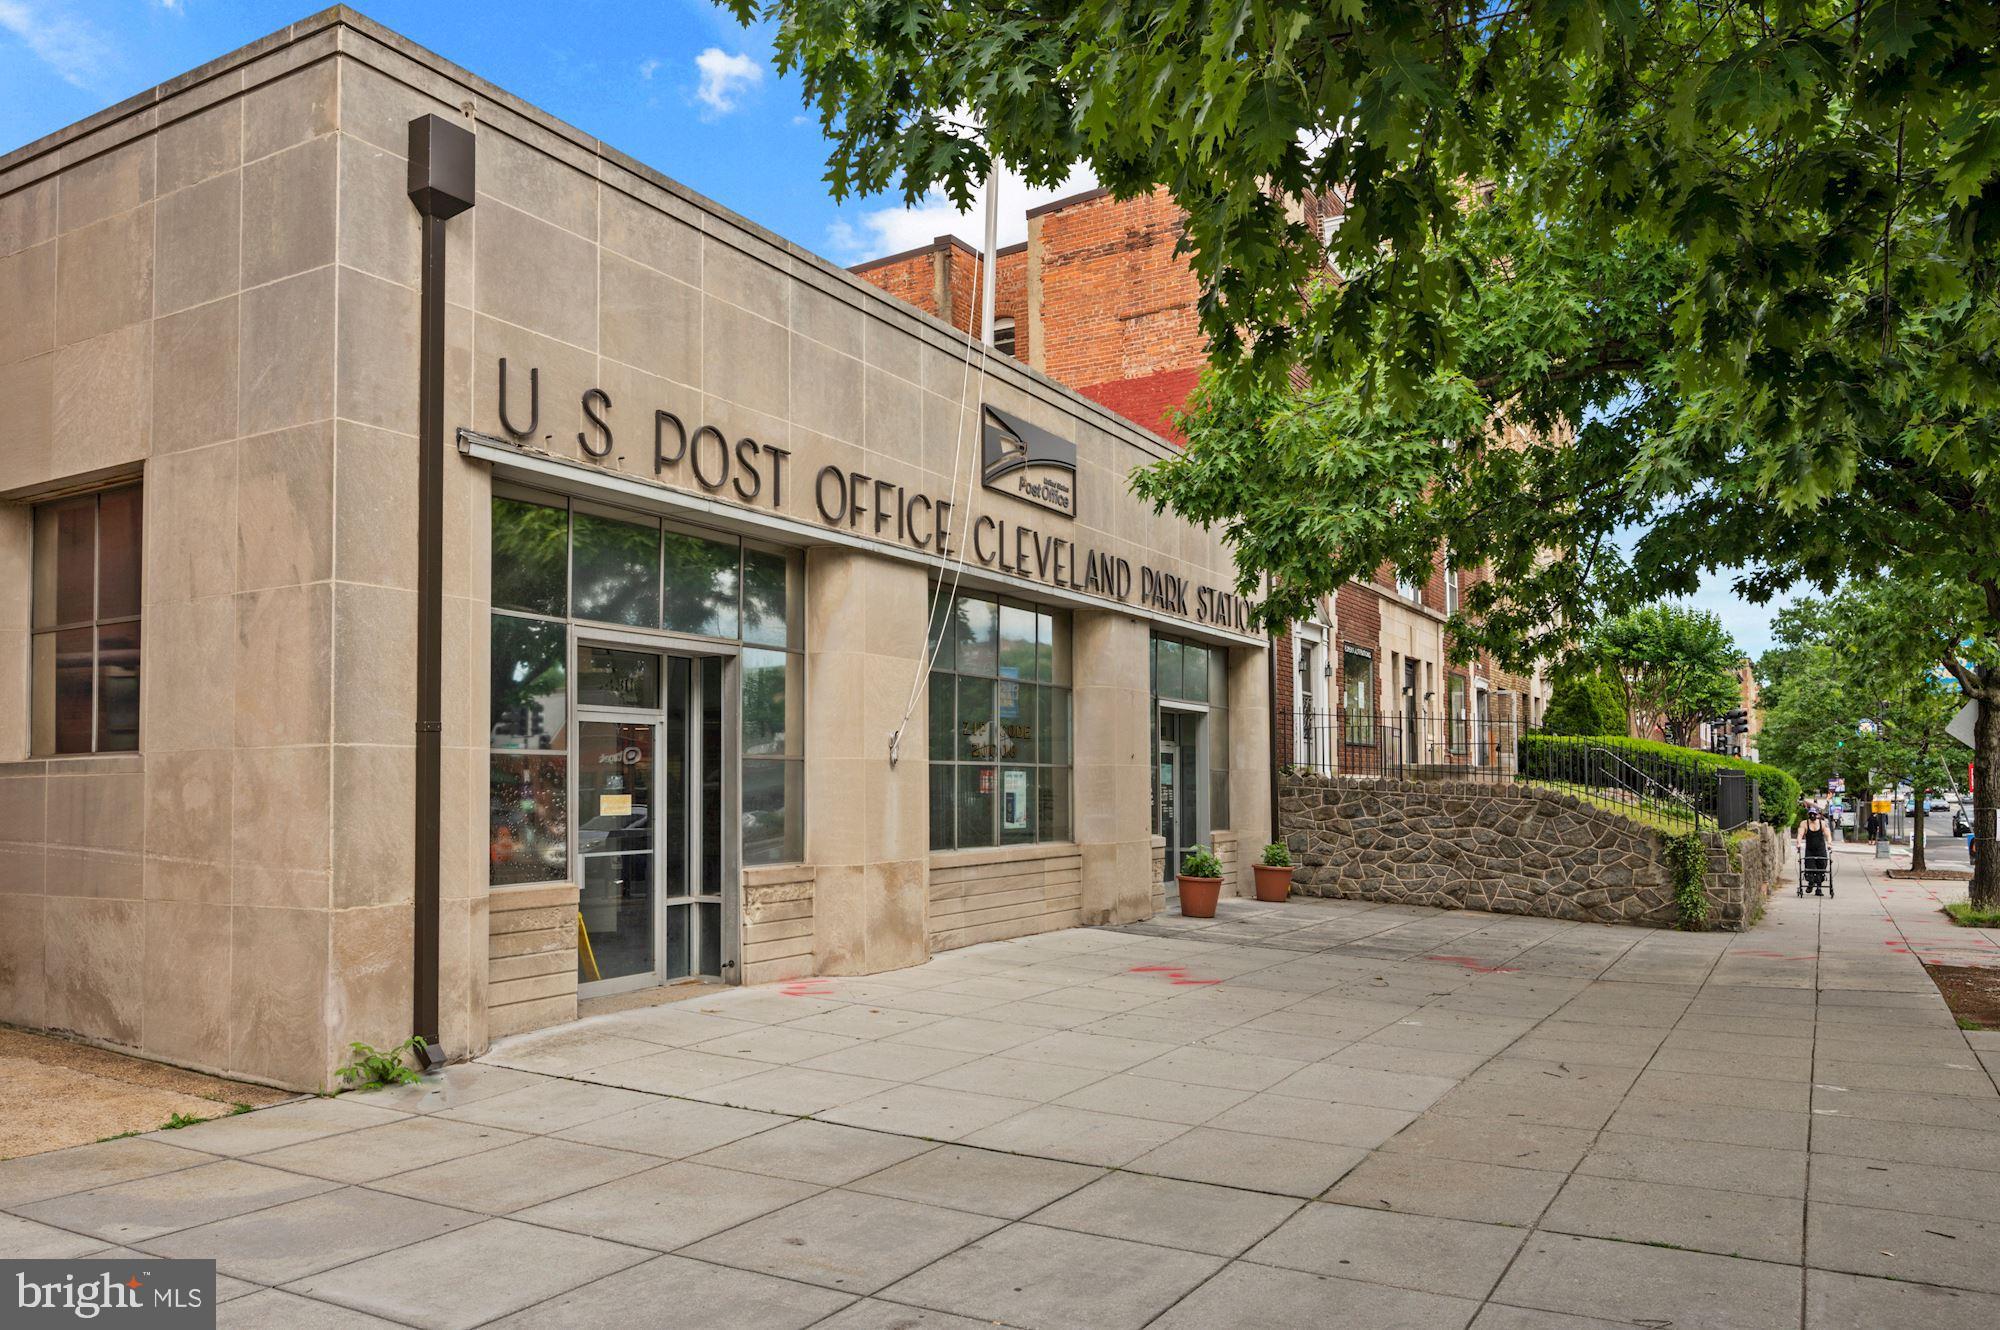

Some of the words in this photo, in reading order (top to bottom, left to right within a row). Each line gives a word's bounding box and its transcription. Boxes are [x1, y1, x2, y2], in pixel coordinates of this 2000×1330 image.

[655, 409, 792, 508] POST
[815, 464, 956, 554] OFFICE
[973, 514, 1132, 600] CLEVELAND
[1140, 565, 1190, 616] PARK
[1018, 475, 1041, 499] Post
[1041, 485, 1070, 509] Office
